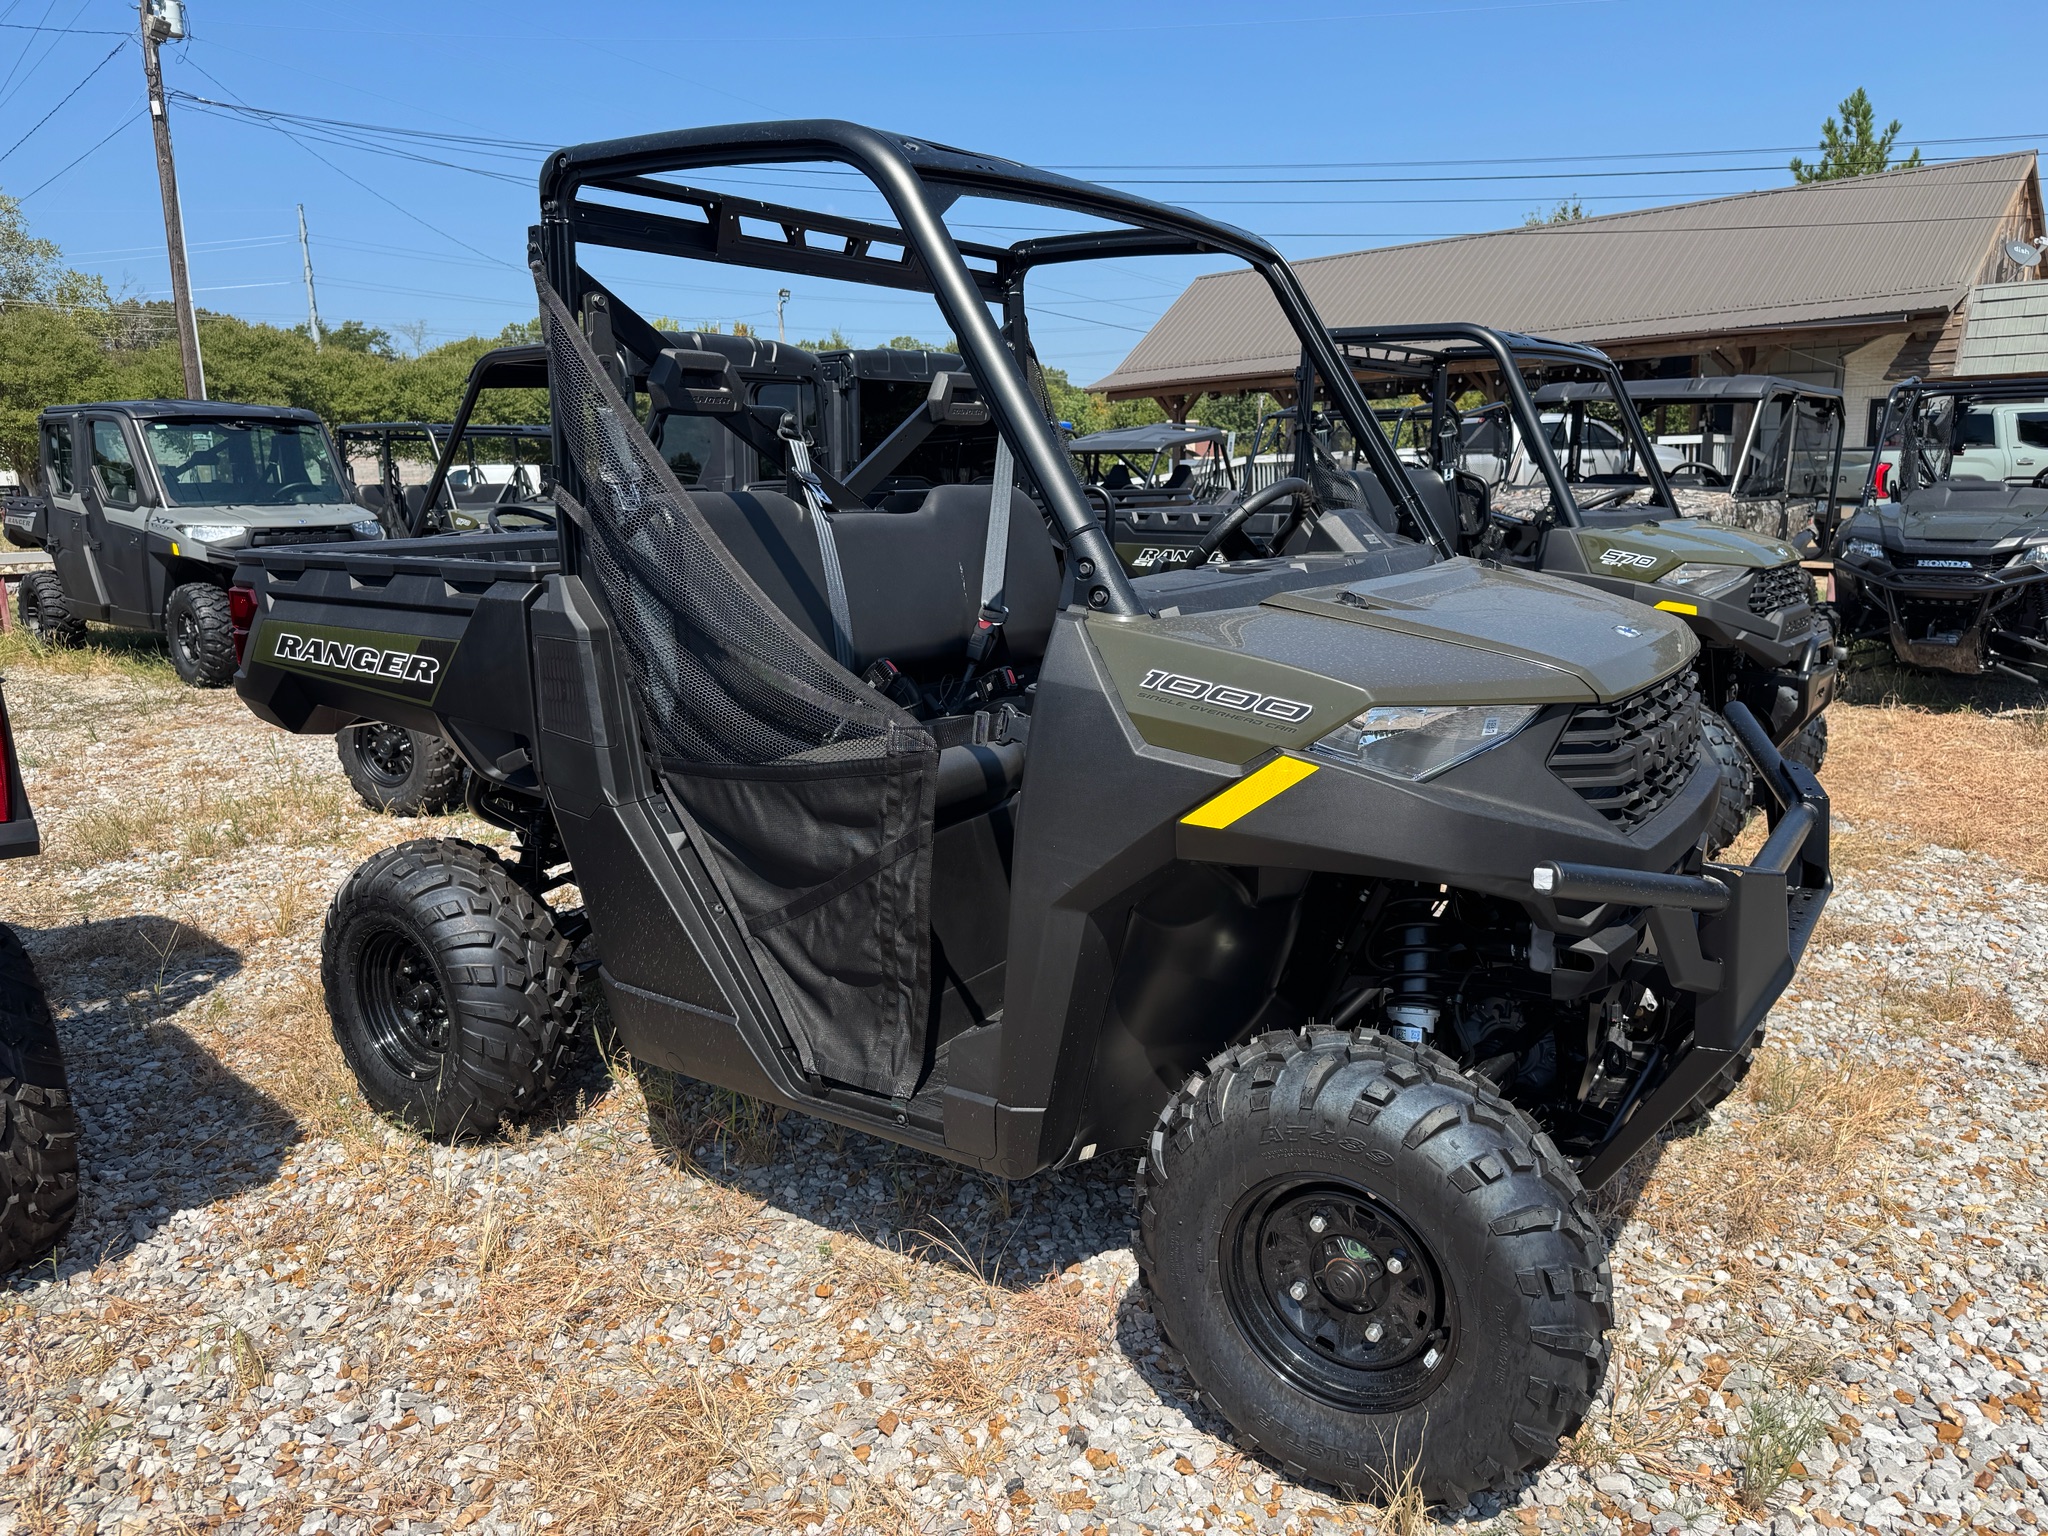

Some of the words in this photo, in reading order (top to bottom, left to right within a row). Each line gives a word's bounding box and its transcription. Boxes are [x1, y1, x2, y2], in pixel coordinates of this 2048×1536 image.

[2013, 245, 2030, 255] dish
[7, 517, 31, 527] RANGER
[152, 516, 174, 524] XP
[1138, 547, 1227, 566] RANE
[1600, 548, 1657, 568] 570
[1916, 559, 1973, 569] HONDA
[274, 632, 440, 684] RANGER
[1139, 668, 1314, 723] 1000
[1136, 692, 1187, 708] SINGLE
[1189, 704, 1264, 726] OVERHEAD
[1264, 722, 1298, 734] CAM
[1259, 1125, 1395, 1166] AT489
